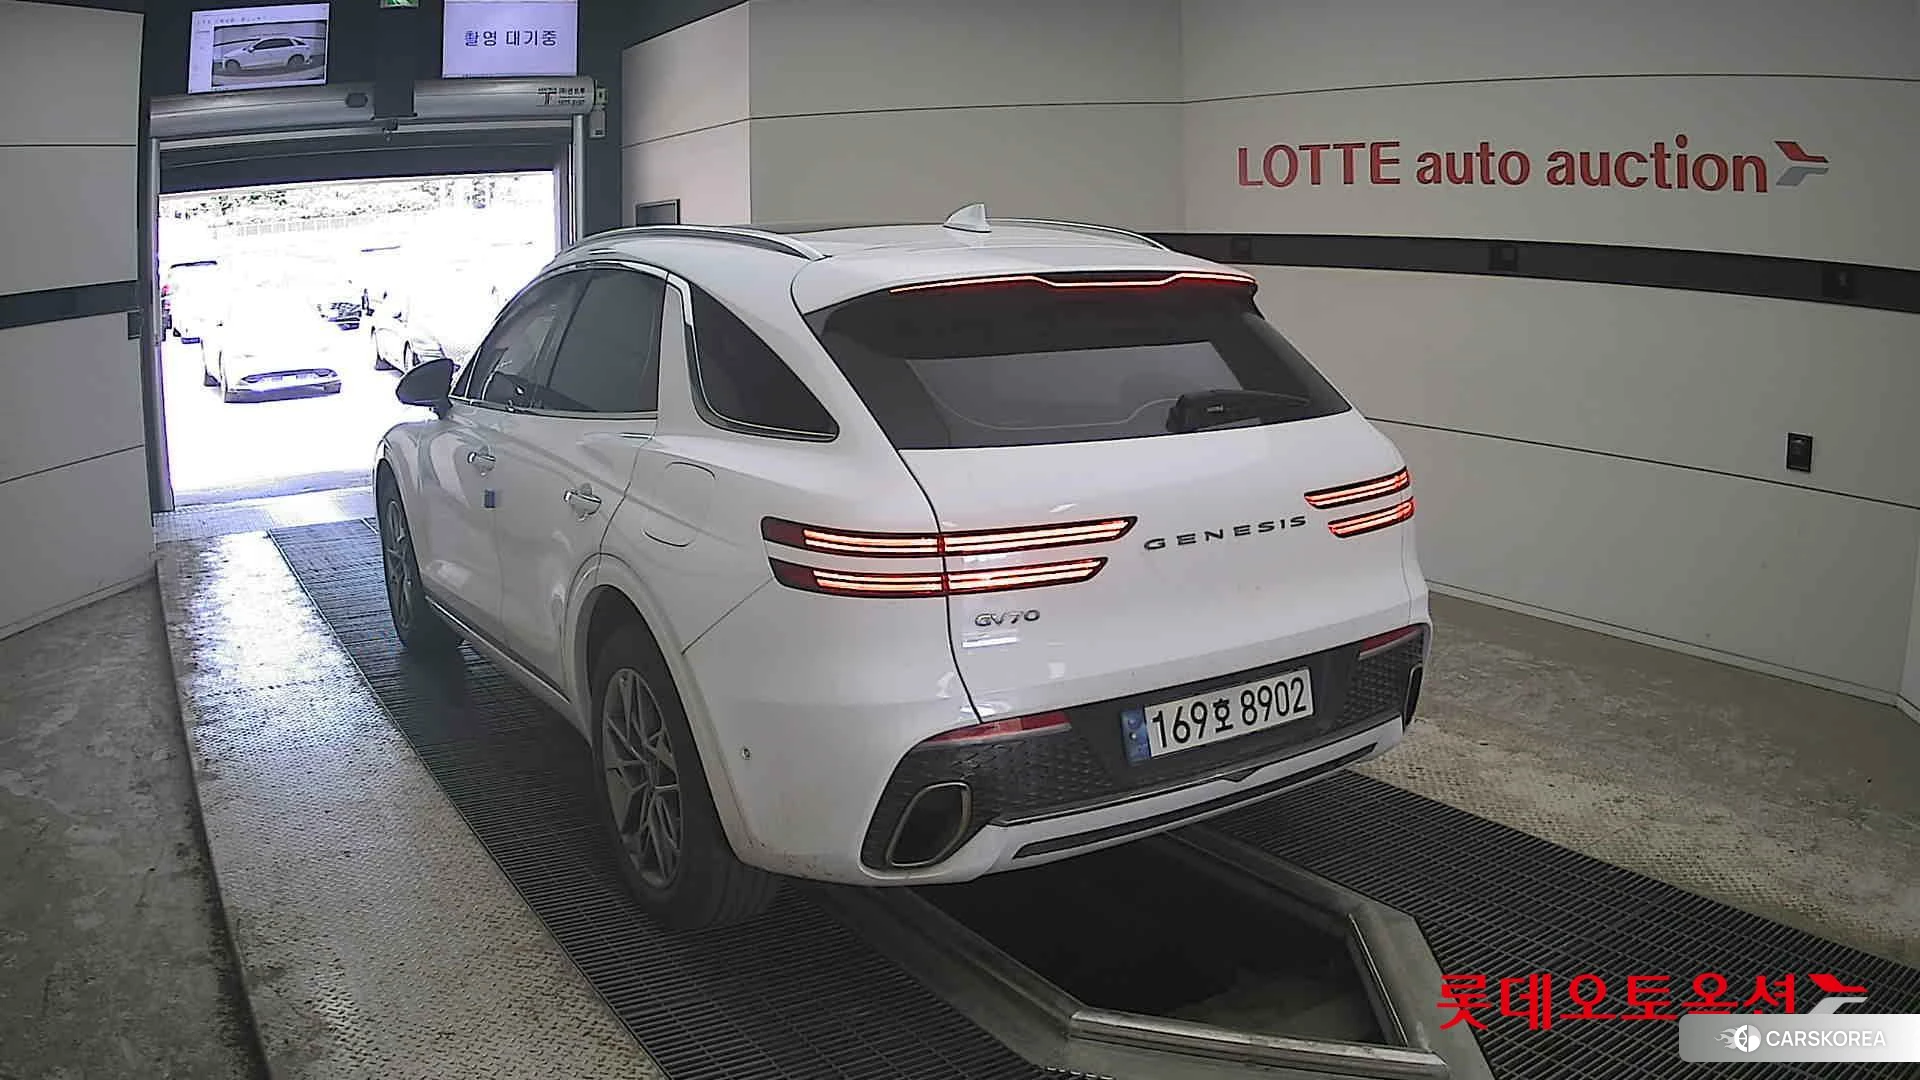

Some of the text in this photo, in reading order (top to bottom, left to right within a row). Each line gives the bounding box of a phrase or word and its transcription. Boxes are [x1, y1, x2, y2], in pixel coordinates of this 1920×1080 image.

[506, 30, 558, 47] 대기중
[1238, 134, 1767, 192] LOTTE auto auction
[1144, 515, 1307, 550] GENESIS
[975, 609, 1040, 627] GV70
[1151, 677, 1307, 748] 169호 8902
